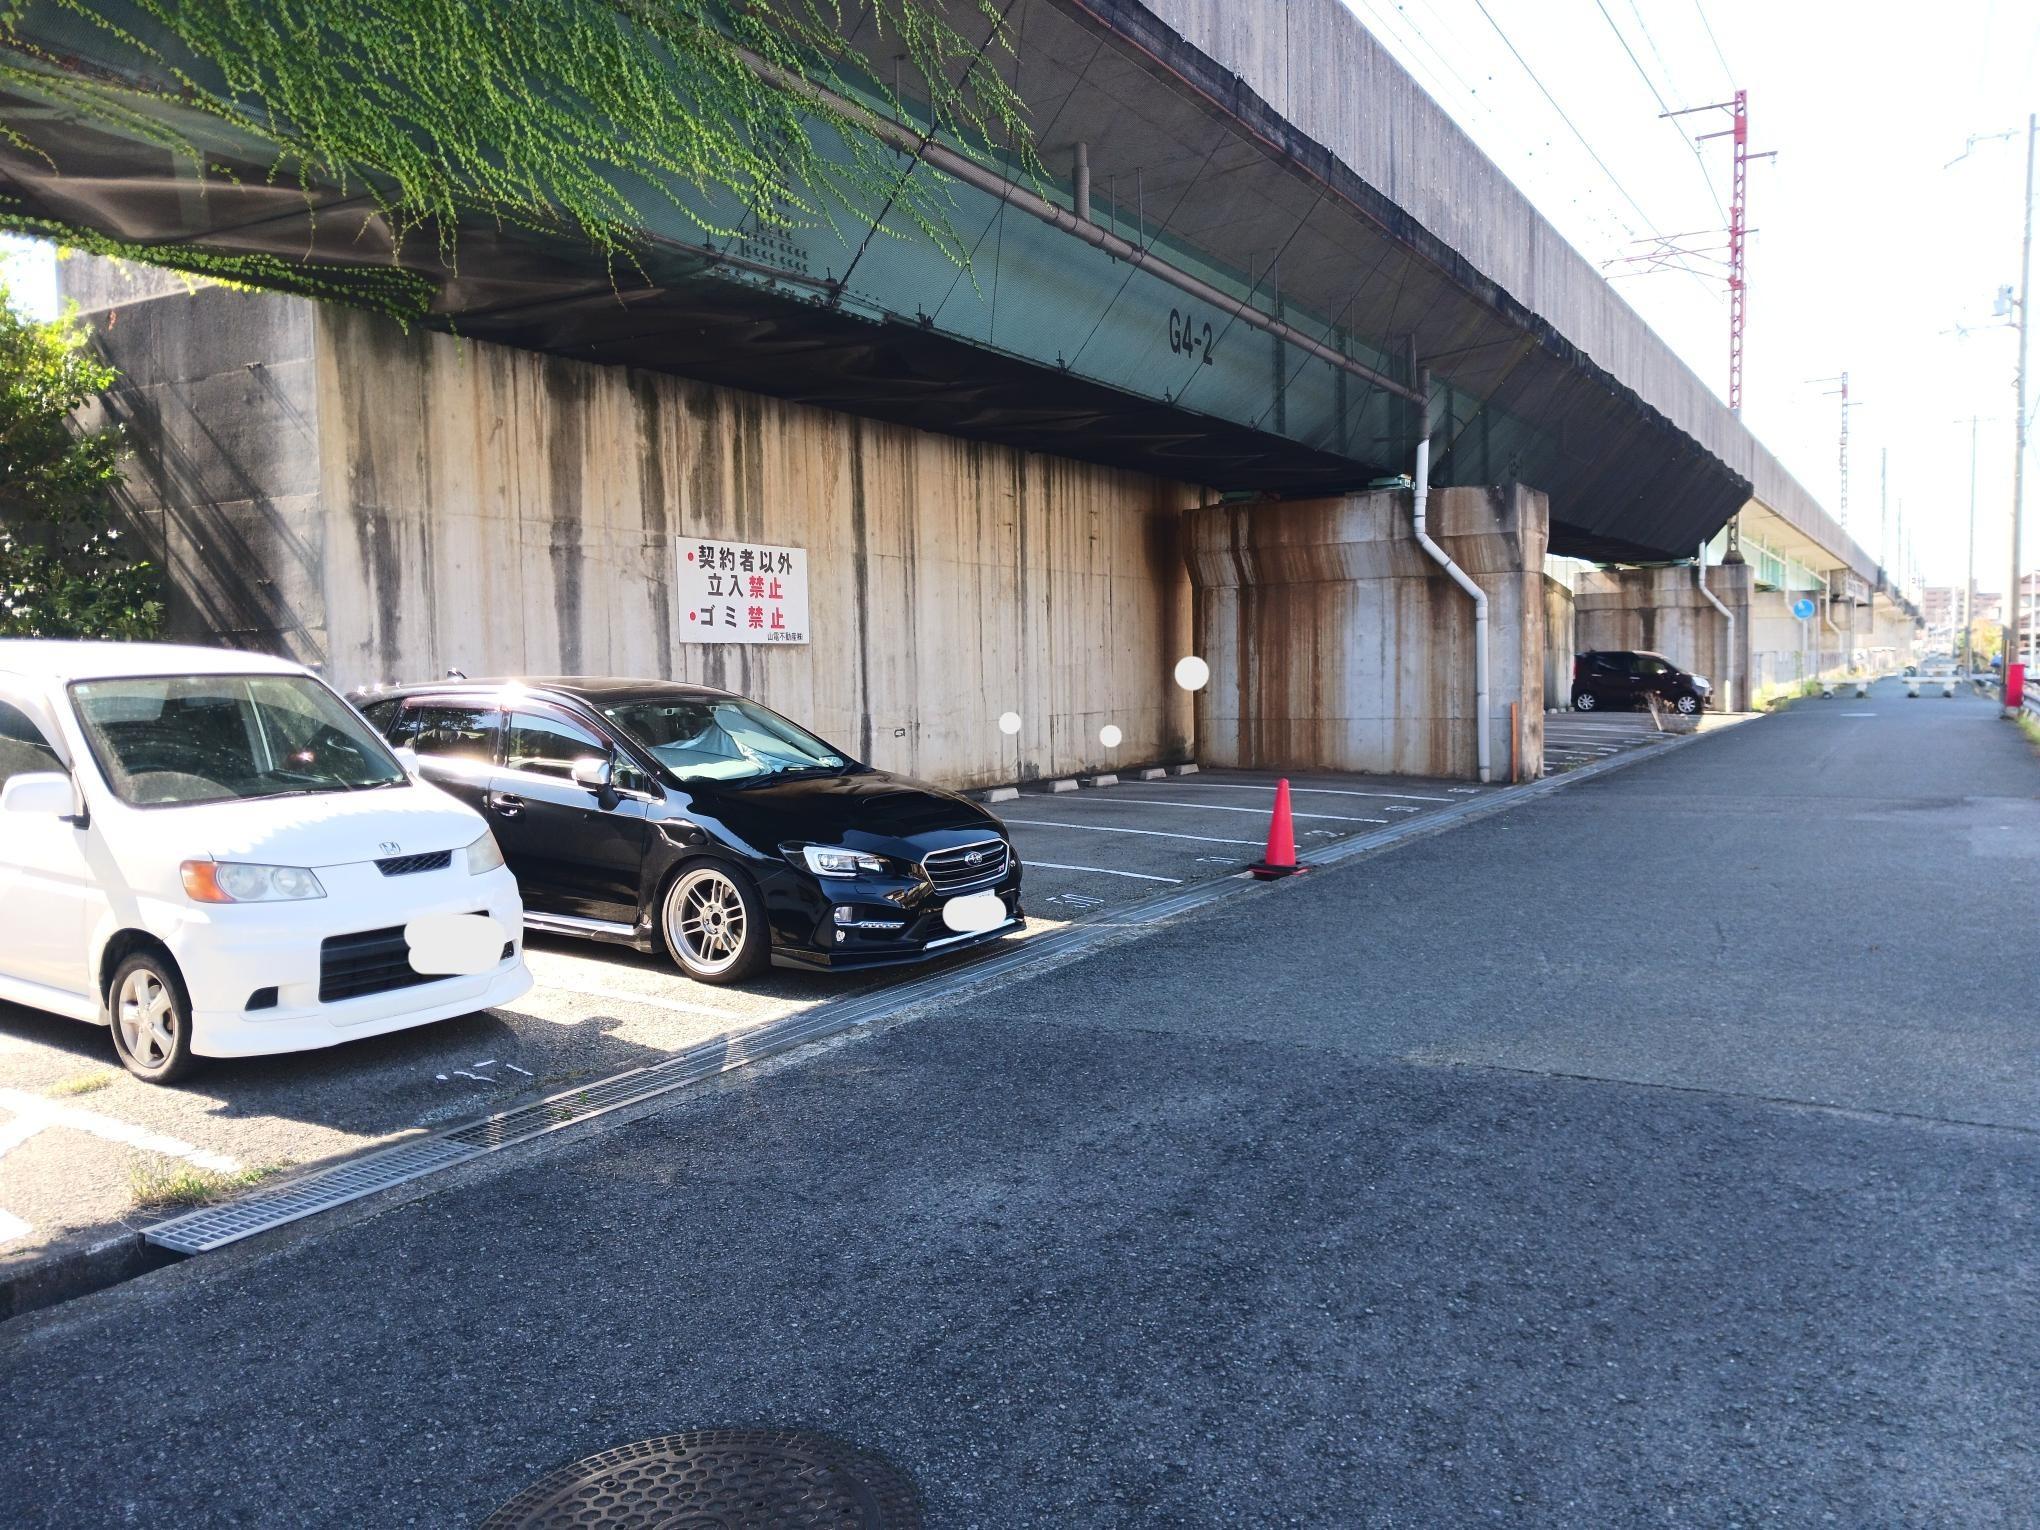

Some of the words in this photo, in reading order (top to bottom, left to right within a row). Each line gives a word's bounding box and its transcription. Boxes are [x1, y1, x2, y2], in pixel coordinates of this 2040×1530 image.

[1169, 308, 1213, 366] G4-2
[698, 545, 793, 575] 契約者以外
[707, 573, 783, 599] 立入禁止
[700, 604, 785, 629] ゴミ禁止
